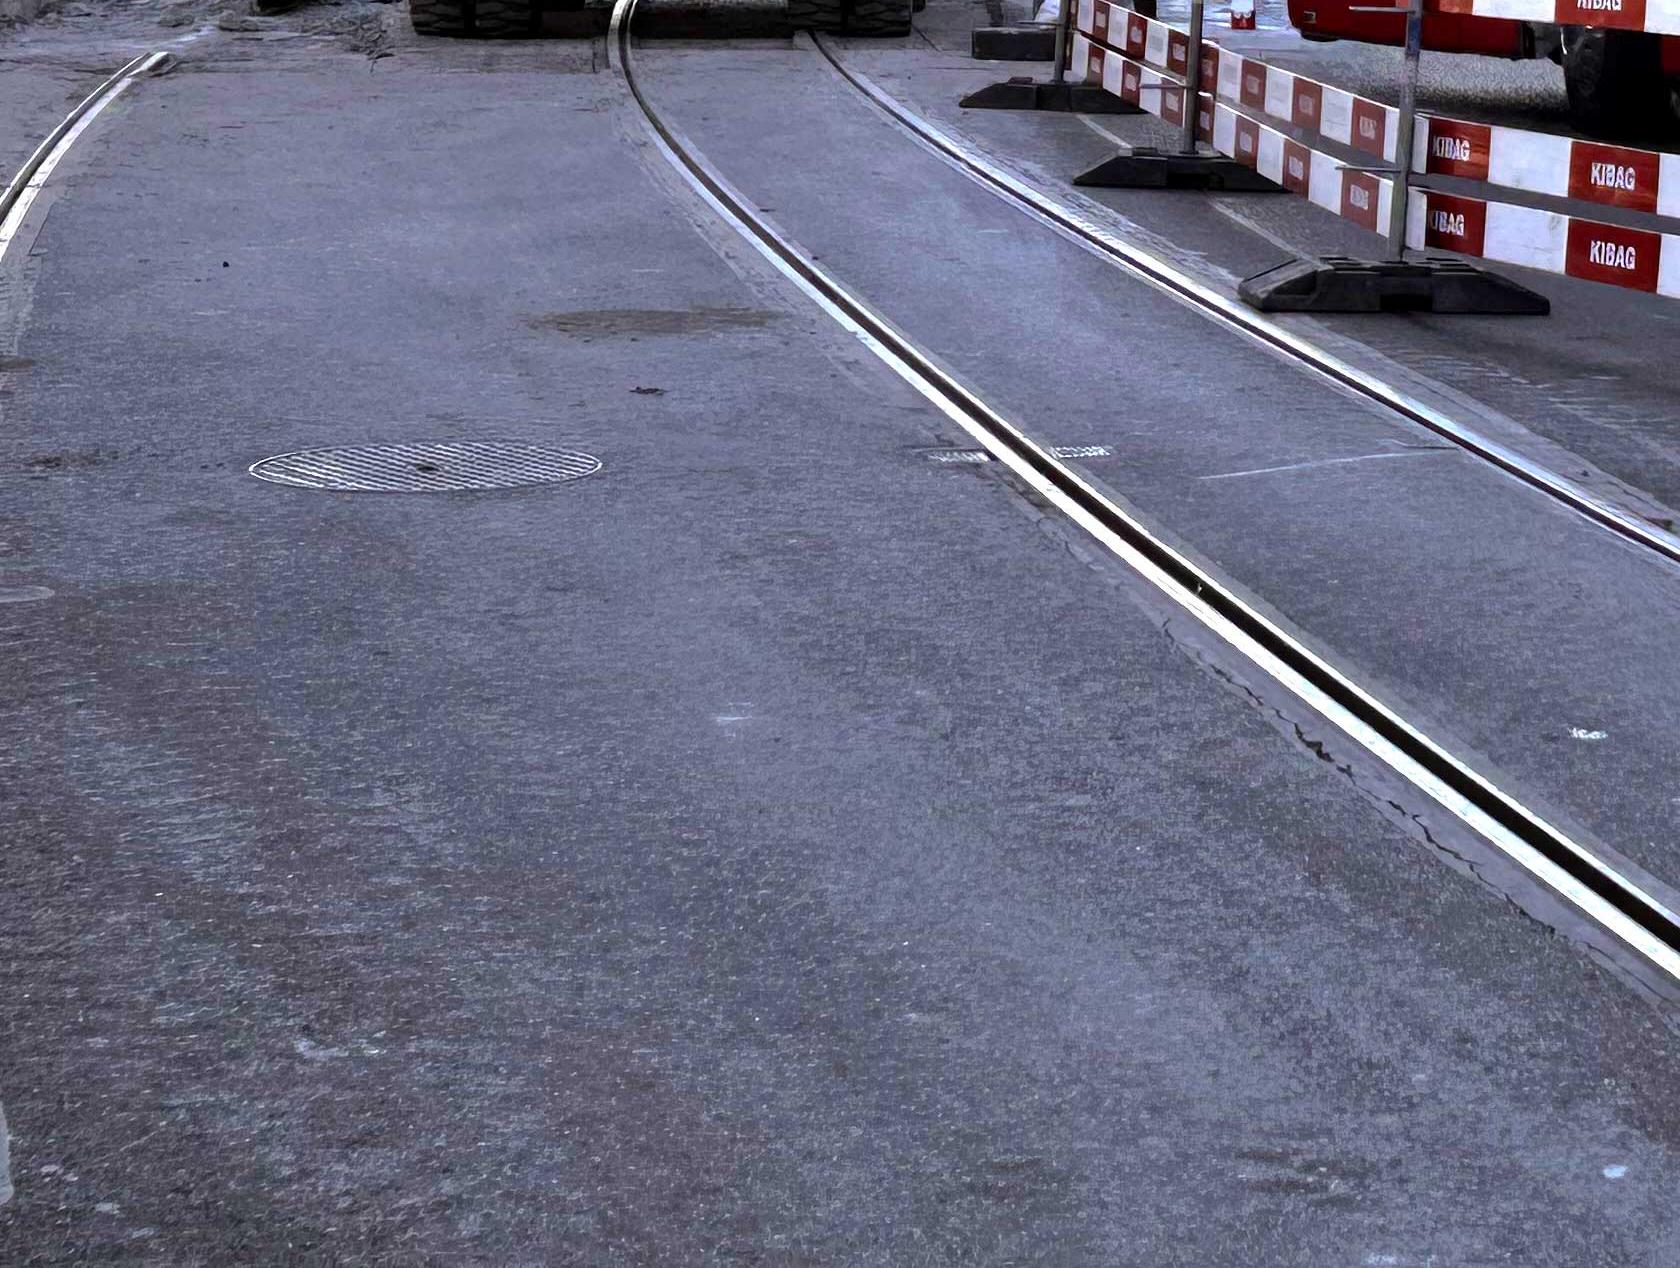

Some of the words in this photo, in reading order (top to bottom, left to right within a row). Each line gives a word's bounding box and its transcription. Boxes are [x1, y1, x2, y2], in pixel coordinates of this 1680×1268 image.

[1432, 136, 1471, 162] KIBAG
[1591, 162, 1636, 190] KIBAG
[1590, 240, 1636, 270] KIBAG
